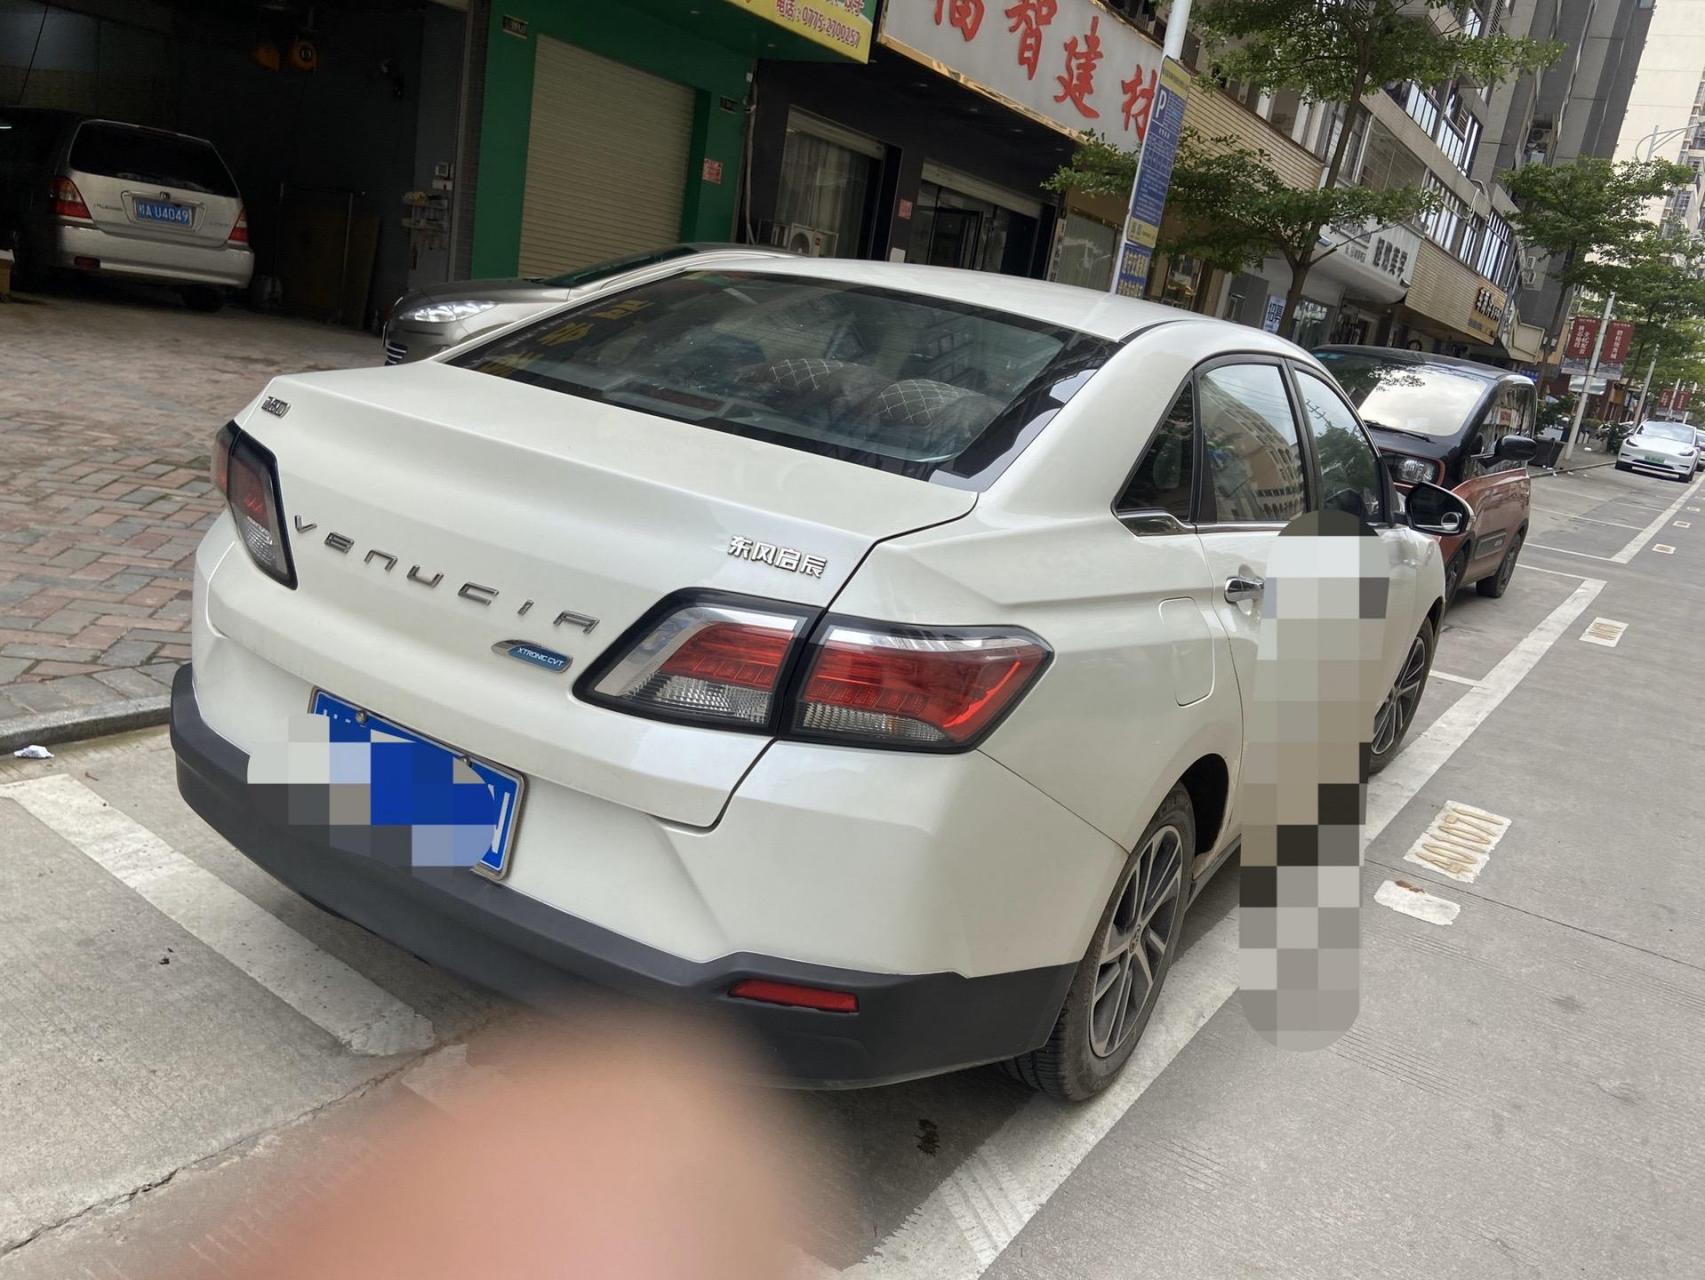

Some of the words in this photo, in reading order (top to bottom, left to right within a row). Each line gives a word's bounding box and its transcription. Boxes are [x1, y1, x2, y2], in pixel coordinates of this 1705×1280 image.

[727, 535, 827, 579] 东风启辰
[517, 647, 547, 662] XTRONIC
[548, 656, 565, 667] CVT
